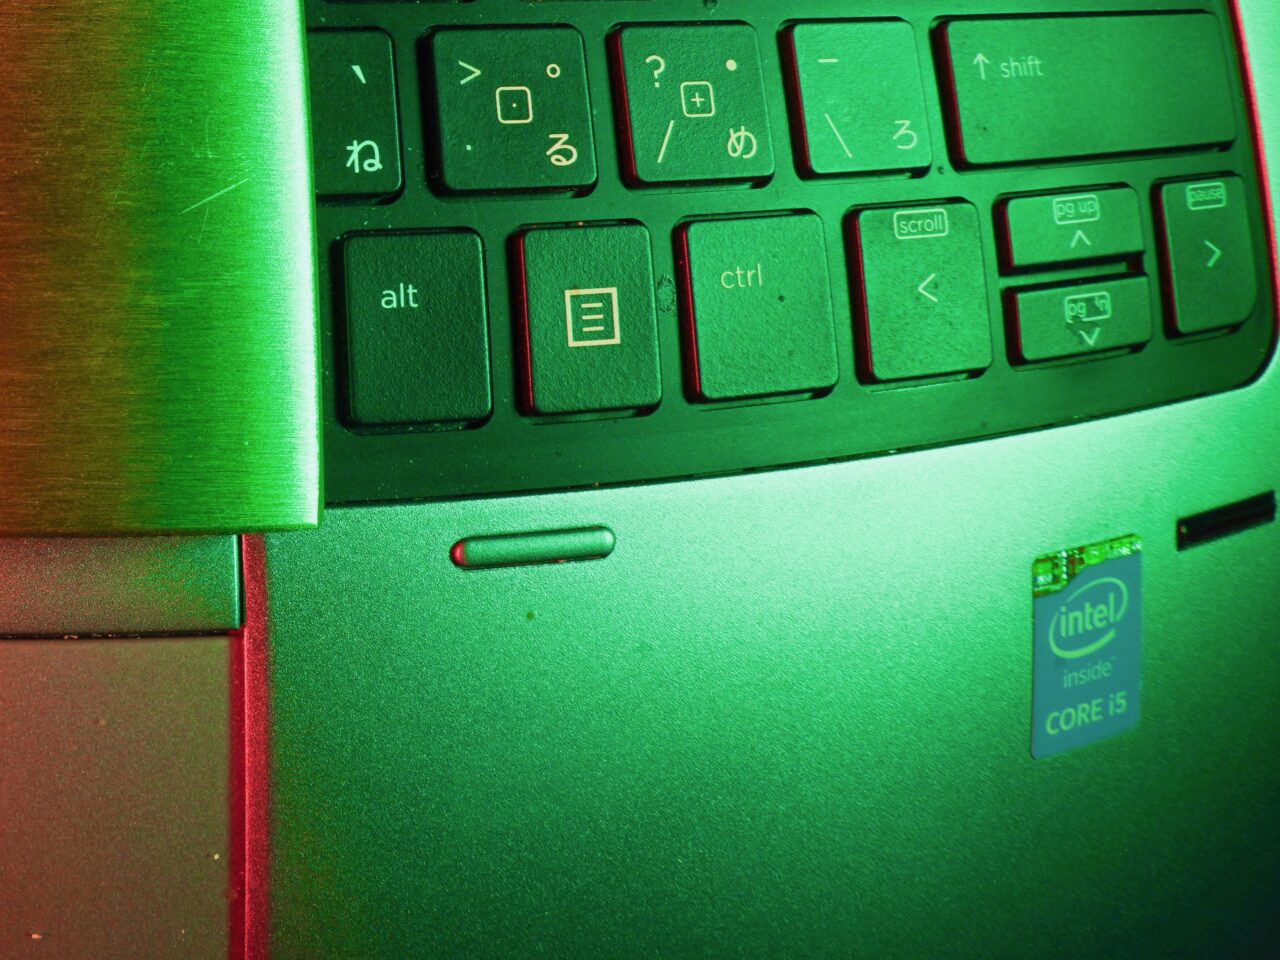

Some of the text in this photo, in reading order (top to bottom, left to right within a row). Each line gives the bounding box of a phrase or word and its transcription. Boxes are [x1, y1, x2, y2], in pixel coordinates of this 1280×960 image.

[646, 55, 665, 87] ?
[1000, 56, 1042, 78] shift
[728, 126, 757, 158] め
[893, 120, 917, 149] ろ
[346, 140, 382, 173] ね
[546, 134, 577, 165] る
[1056, 196, 1098, 220] pg up
[898, 214, 945, 234] scroll
[721, 264, 761, 288] ctrl
[381, 283, 418, 308] alt
[1066, 299, 1088, 320] pg
[1059, 592, 1116, 638] intel
[1063, 659, 1113, 689] inside
[1045, 690, 1128, 735] CORE i5
